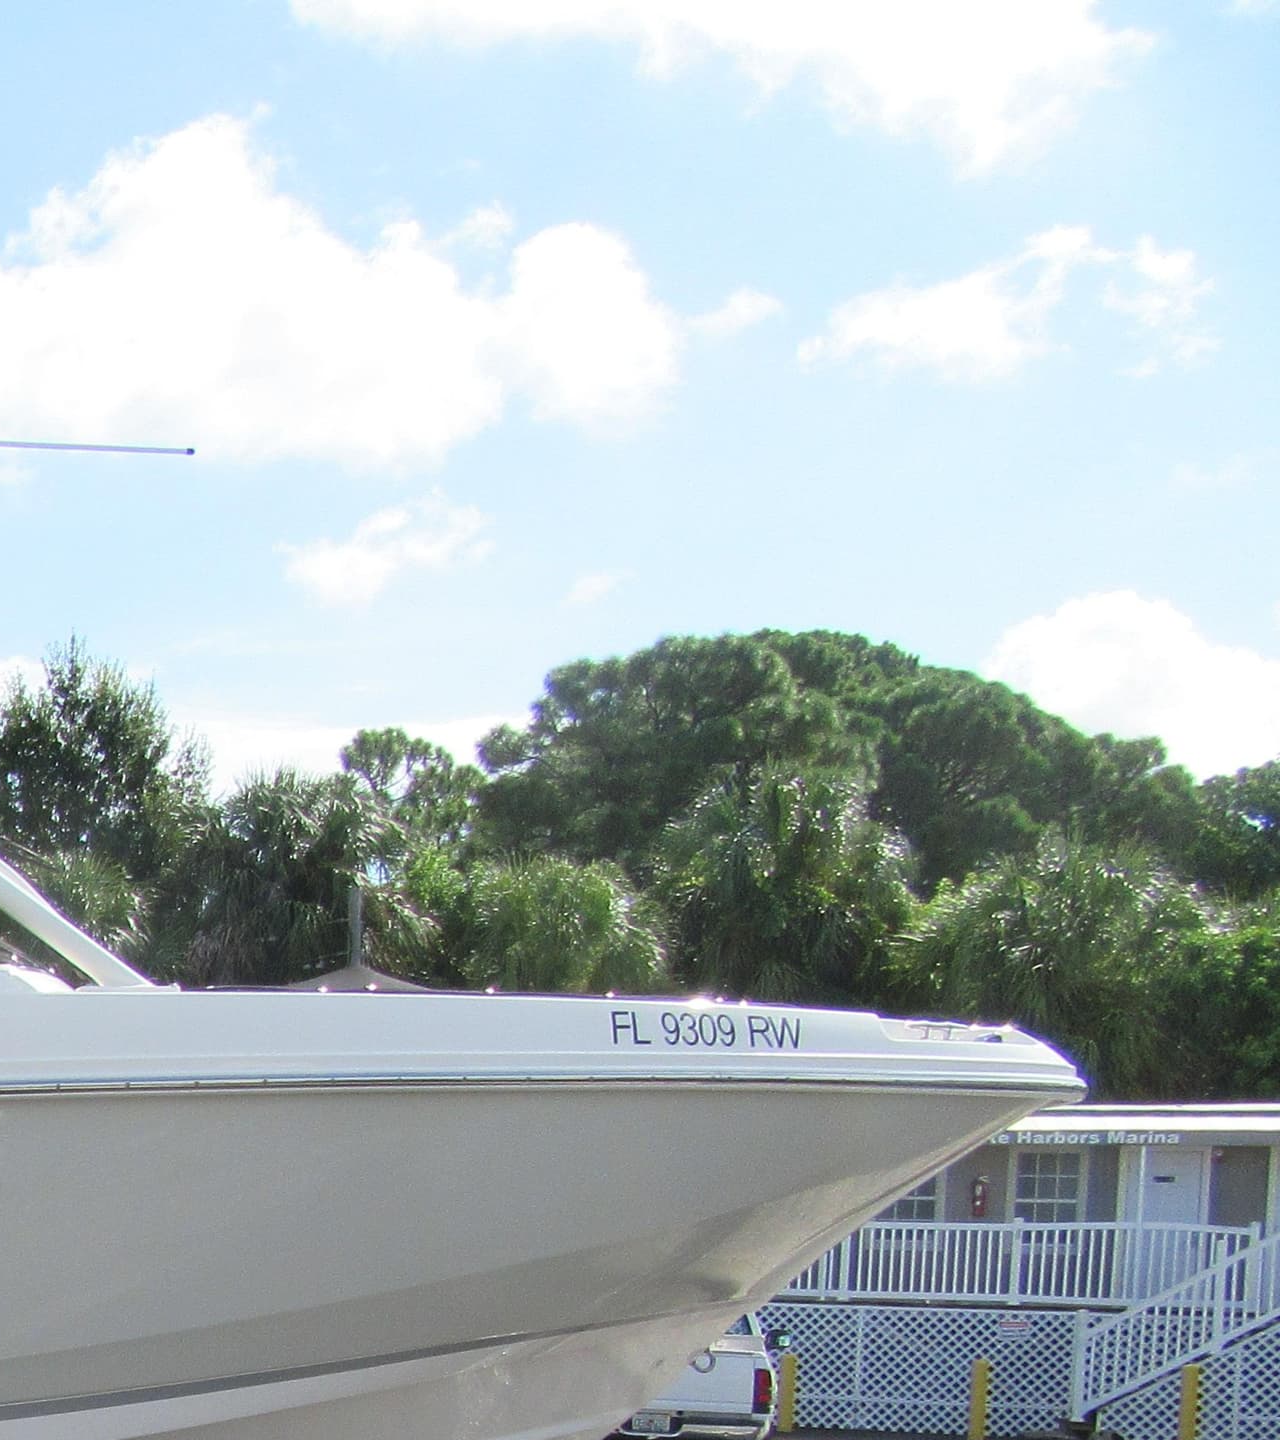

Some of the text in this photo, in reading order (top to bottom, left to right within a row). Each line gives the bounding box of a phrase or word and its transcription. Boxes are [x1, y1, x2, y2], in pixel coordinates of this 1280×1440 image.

[611, 1010, 801, 1049] FL 9309 RW
[1016, 1131, 1100, 1145] Harbors
[1107, 1131, 1180, 1145] Marina
